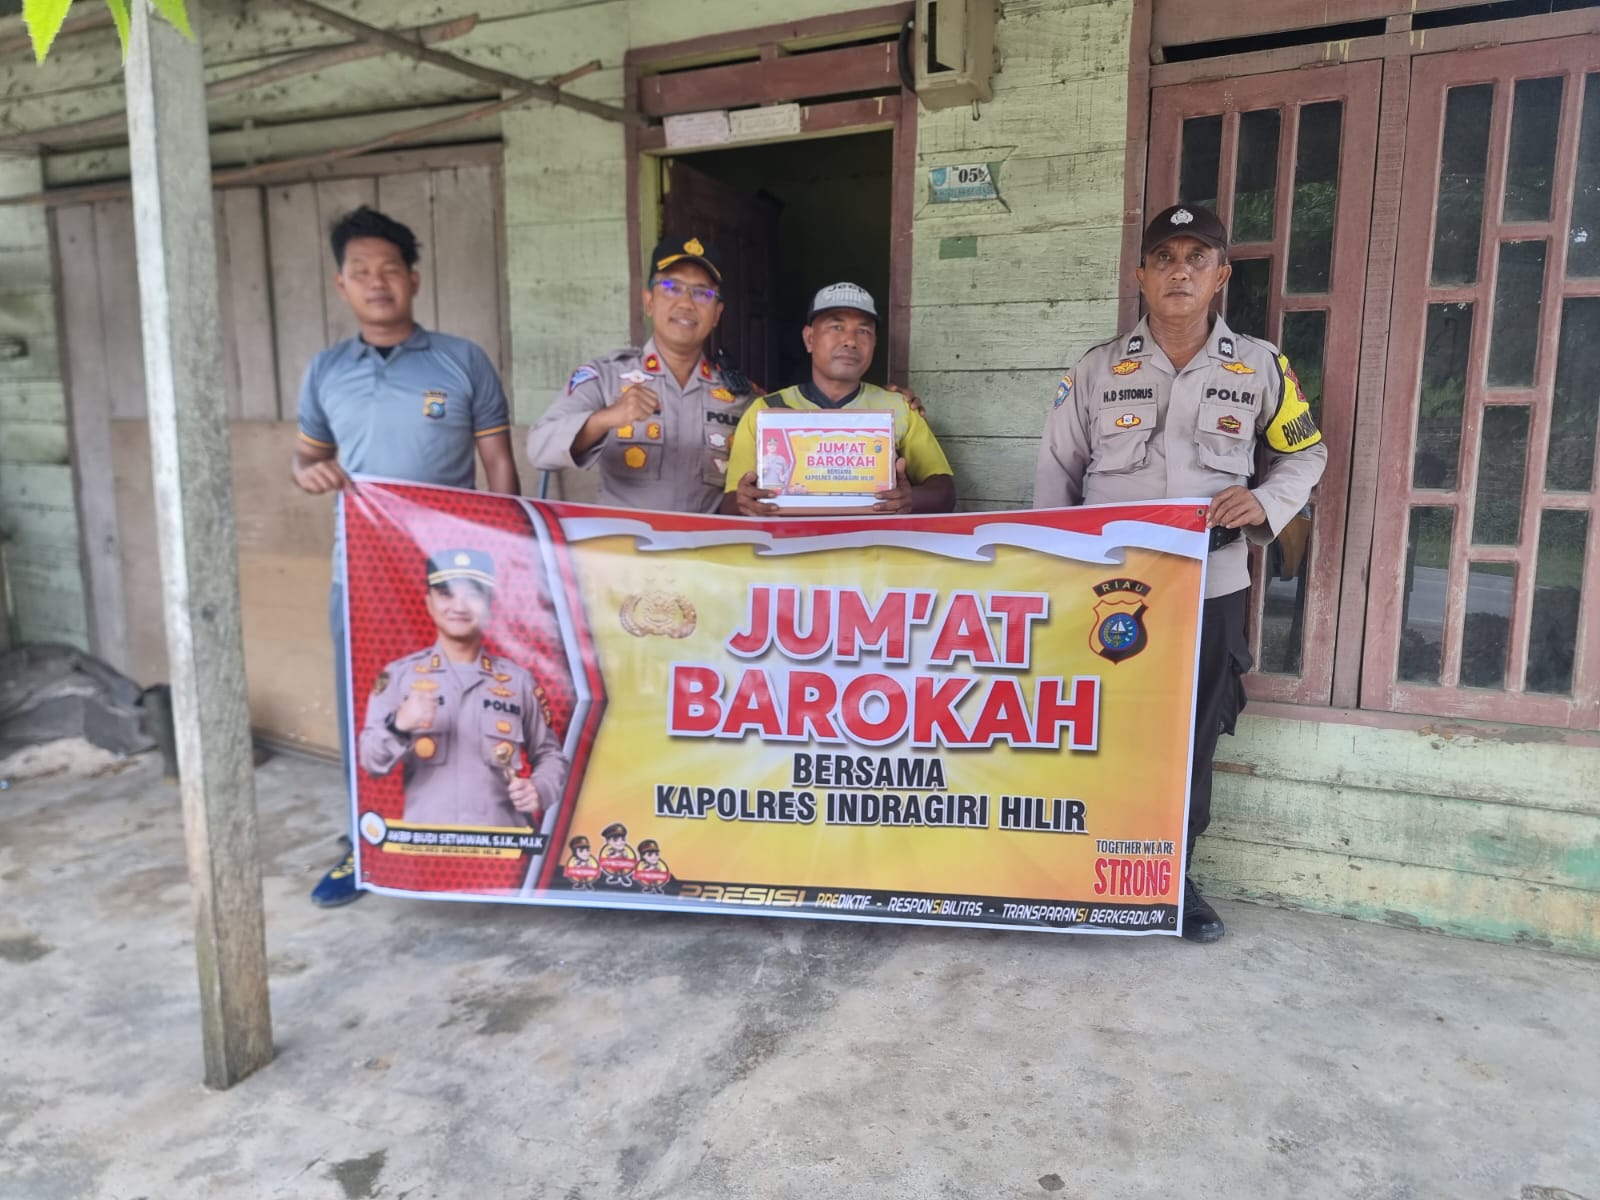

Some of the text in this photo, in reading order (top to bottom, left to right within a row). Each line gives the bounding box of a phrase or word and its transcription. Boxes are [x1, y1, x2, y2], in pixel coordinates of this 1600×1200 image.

[1119, 388, 1153, 401] SITORUS
[1206, 388, 1255, 405] POLRI
[816, 442, 866, 453] JUM'AT
[807, 456, 875, 467] BAROKAH
[1102, 581, 1144, 592] RIAU
[727, 585, 1047, 666] JUM'AT
[669, 663, 1098, 748] BAROKAH
[792, 753, 946, 788] BERSAMA
[655, 785, 1088, 831] KAPOLRES INDRAGIRI HILIR
[1096, 840, 1142, 855] TOGETHER
[1156, 841, 1175, 856] ARE
[1094, 858, 1172, 896] STRONG
[679, 884, 807, 907] PRESISI
[815, 892, 872, 909] PREDIKTIF
[887, 897, 984, 917] RESPONSIBILITAS
[1002, 903, 1089, 923] TRANSPARANSI
[1089, 908, 1166, 925] BERKEADILAN
